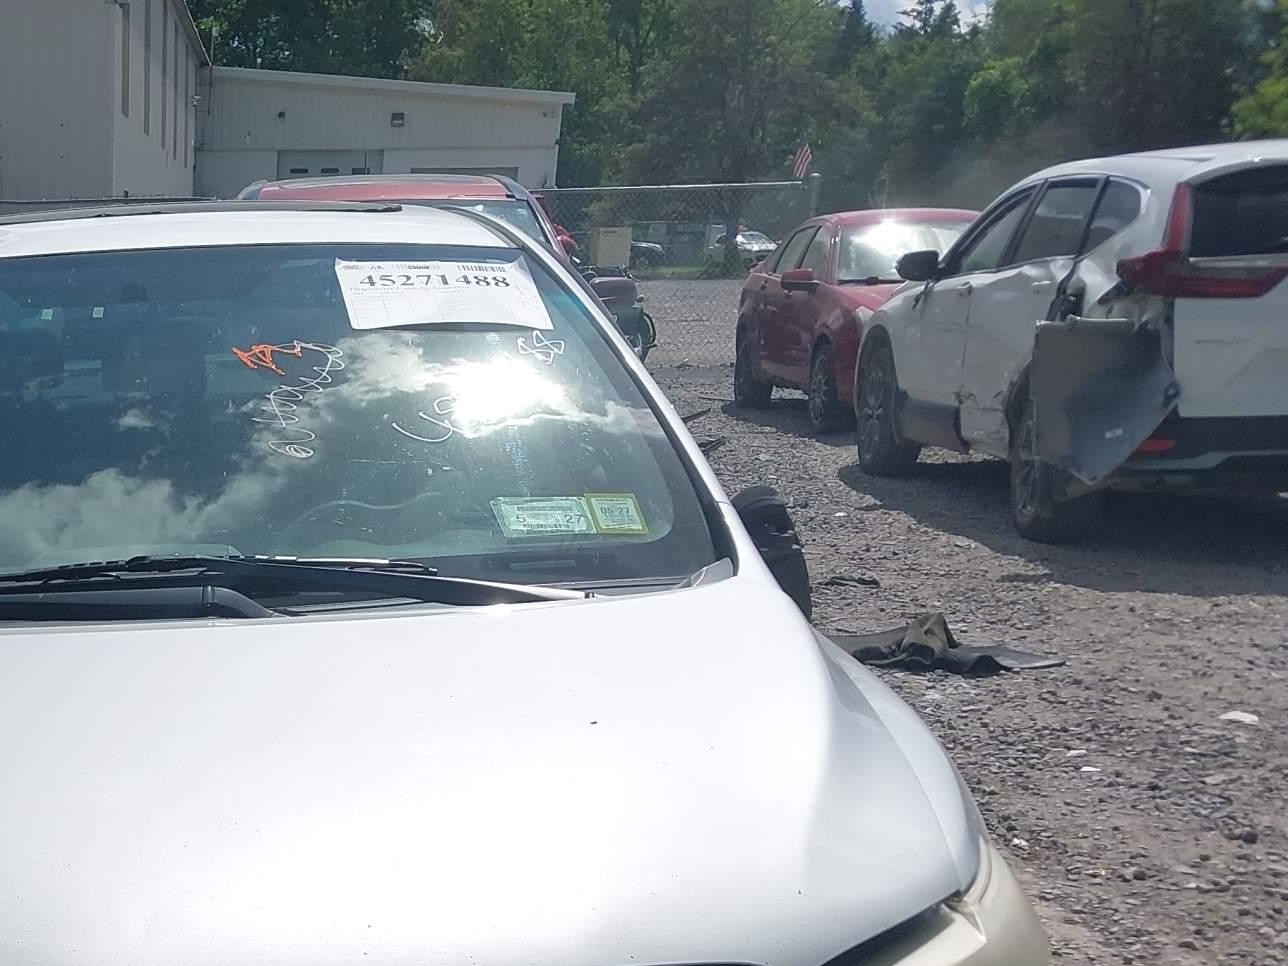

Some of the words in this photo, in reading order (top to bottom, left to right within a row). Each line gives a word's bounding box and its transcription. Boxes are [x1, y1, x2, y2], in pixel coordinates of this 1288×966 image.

[359, 273, 511, 288] 45271488
[515, 513, 527, 524] 5
[564, 513, 583, 524] 27
